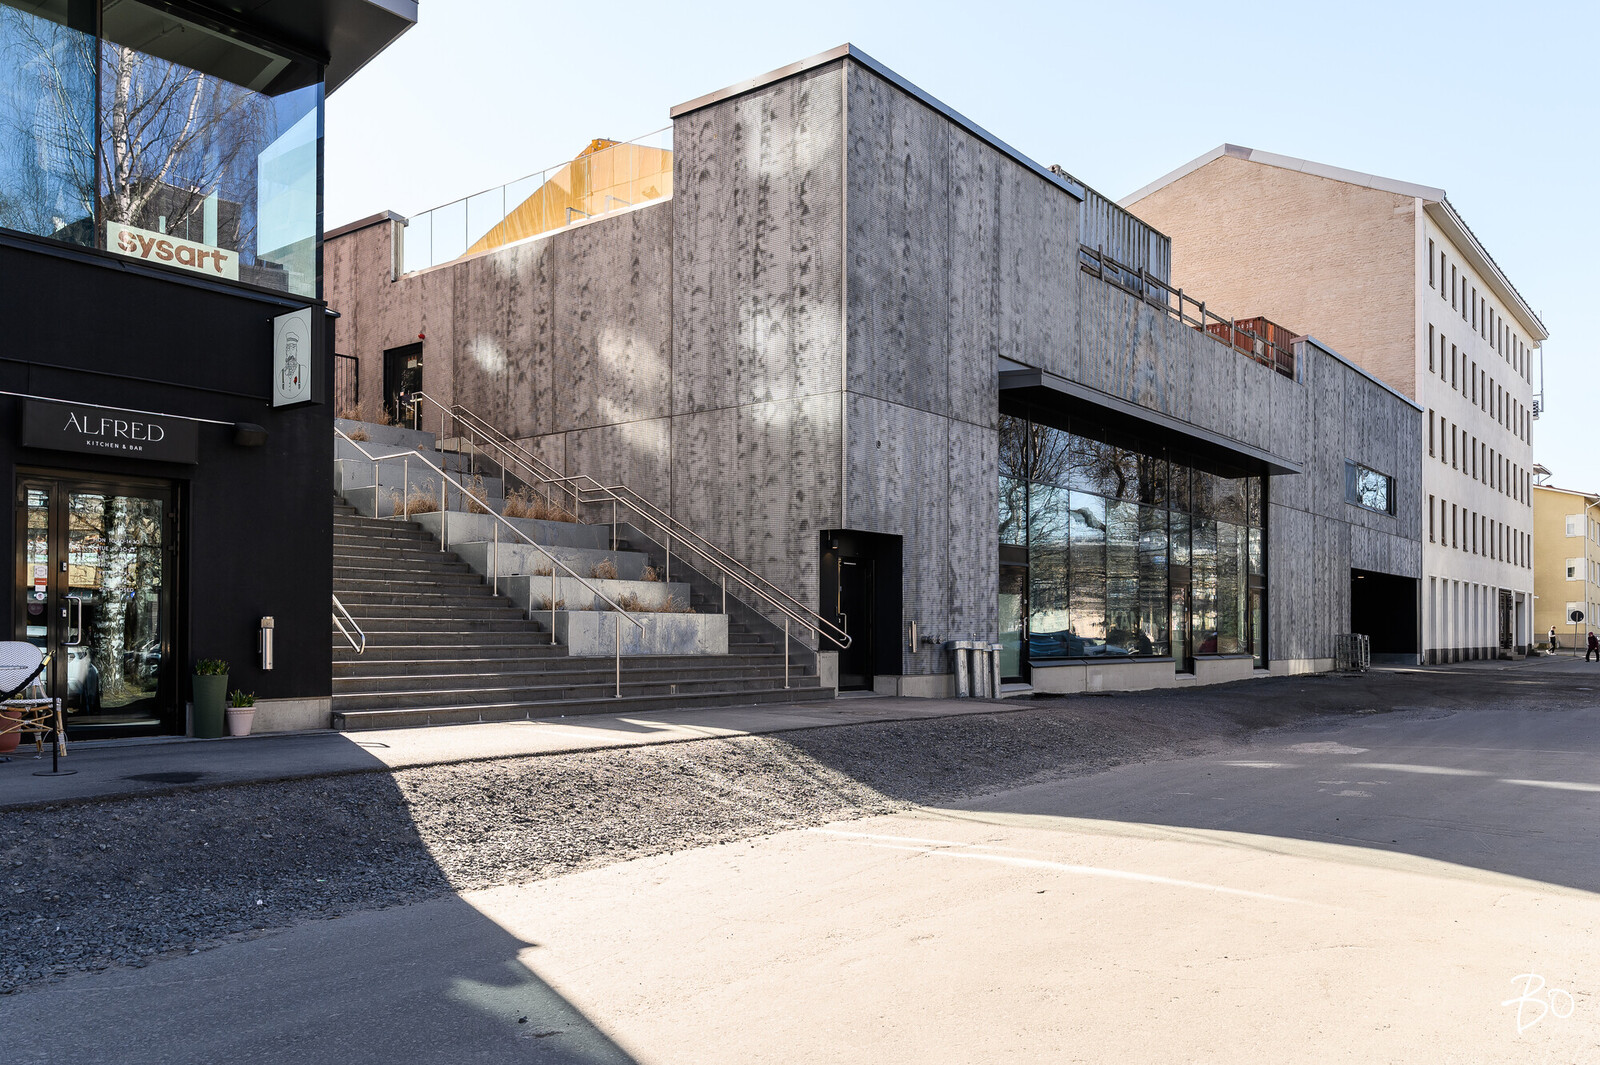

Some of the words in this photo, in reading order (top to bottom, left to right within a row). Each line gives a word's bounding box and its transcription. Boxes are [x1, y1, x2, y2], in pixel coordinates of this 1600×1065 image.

[117, 229, 228, 274] sysart
[63, 411, 165, 442] ALFRED
[86, 440, 120, 449] KITCHEN
[129, 444, 143, 452] BAR
